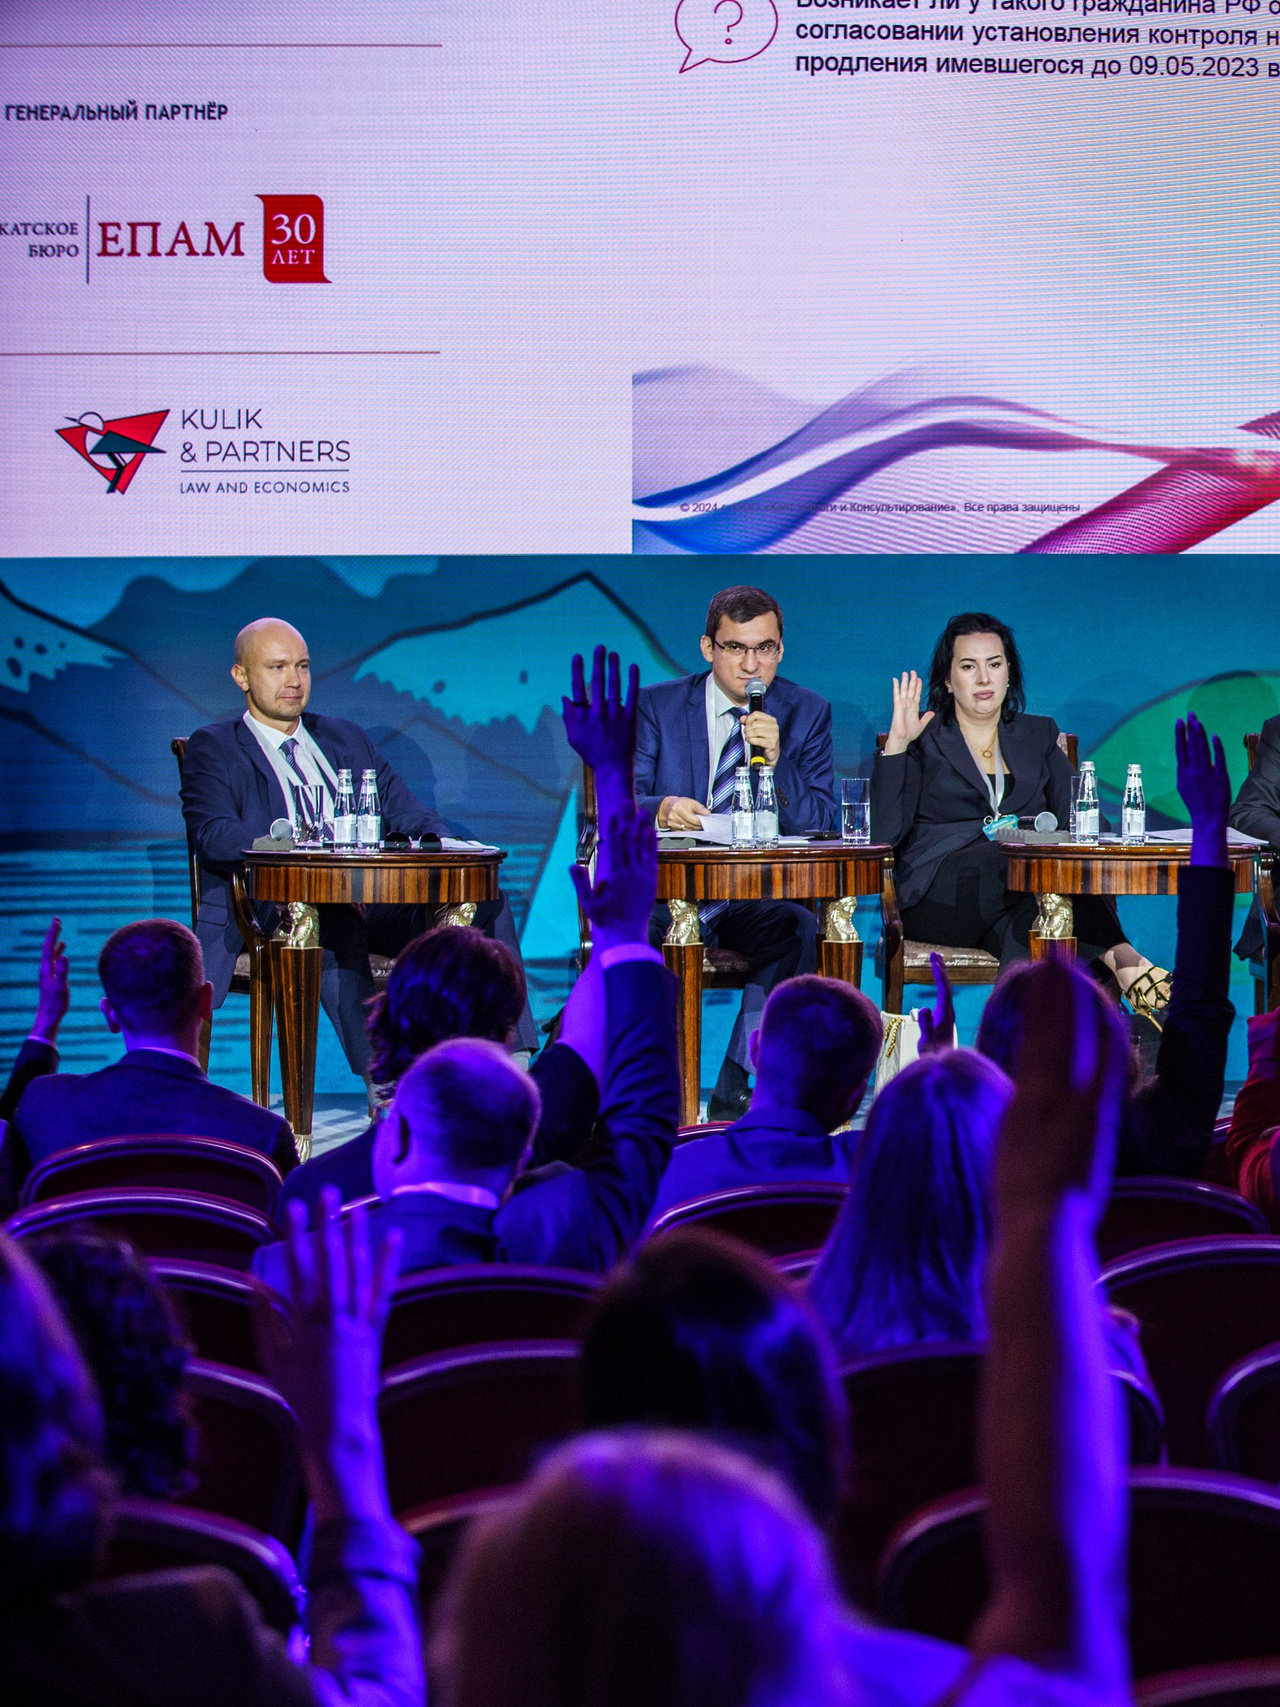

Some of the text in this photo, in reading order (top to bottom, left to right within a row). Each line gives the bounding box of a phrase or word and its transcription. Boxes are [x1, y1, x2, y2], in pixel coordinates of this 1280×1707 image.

[929, 0, 960, 9] ли
[968, 0, 980, 14] у
[991, 0, 1065, 11] такого
[1073, 0, 1215, 16] гражданина
[1225, 0, 1260, 14] РФ
[796, 23, 963, 41] согласовании
[972, 25, 1139, 46] установления
[1148, 27, 1257, 48] контроля
[796, 55, 927, 76] продления
[936, 57, 1083, 74] имевшегося
[1091, 59, 1121, 78] до
[1129, 56, 1259, 77] 09.05.2023
[5, 100, 228, 121] ГЕНЕРАЛЬНЫЙ ПАРТНЁР
[0, 222, 78, 235] КАТСКОЕ
[97, 221, 245, 257] ЕПАМ
[271, 213, 316, 245] 30
[29, 244, 79, 257] БЮРО
[271, 249, 316, 265] ЛЕТ
[182, 408, 262, 430] KULIK
[180, 440, 350, 463] & PARTNERS
[180, 481, 350, 494] LAW AND ECONOMICS
[692, 502, 717, 513] 2024
[964, 503, 985, 512] Все
[987, 505, 1019, 514] права
